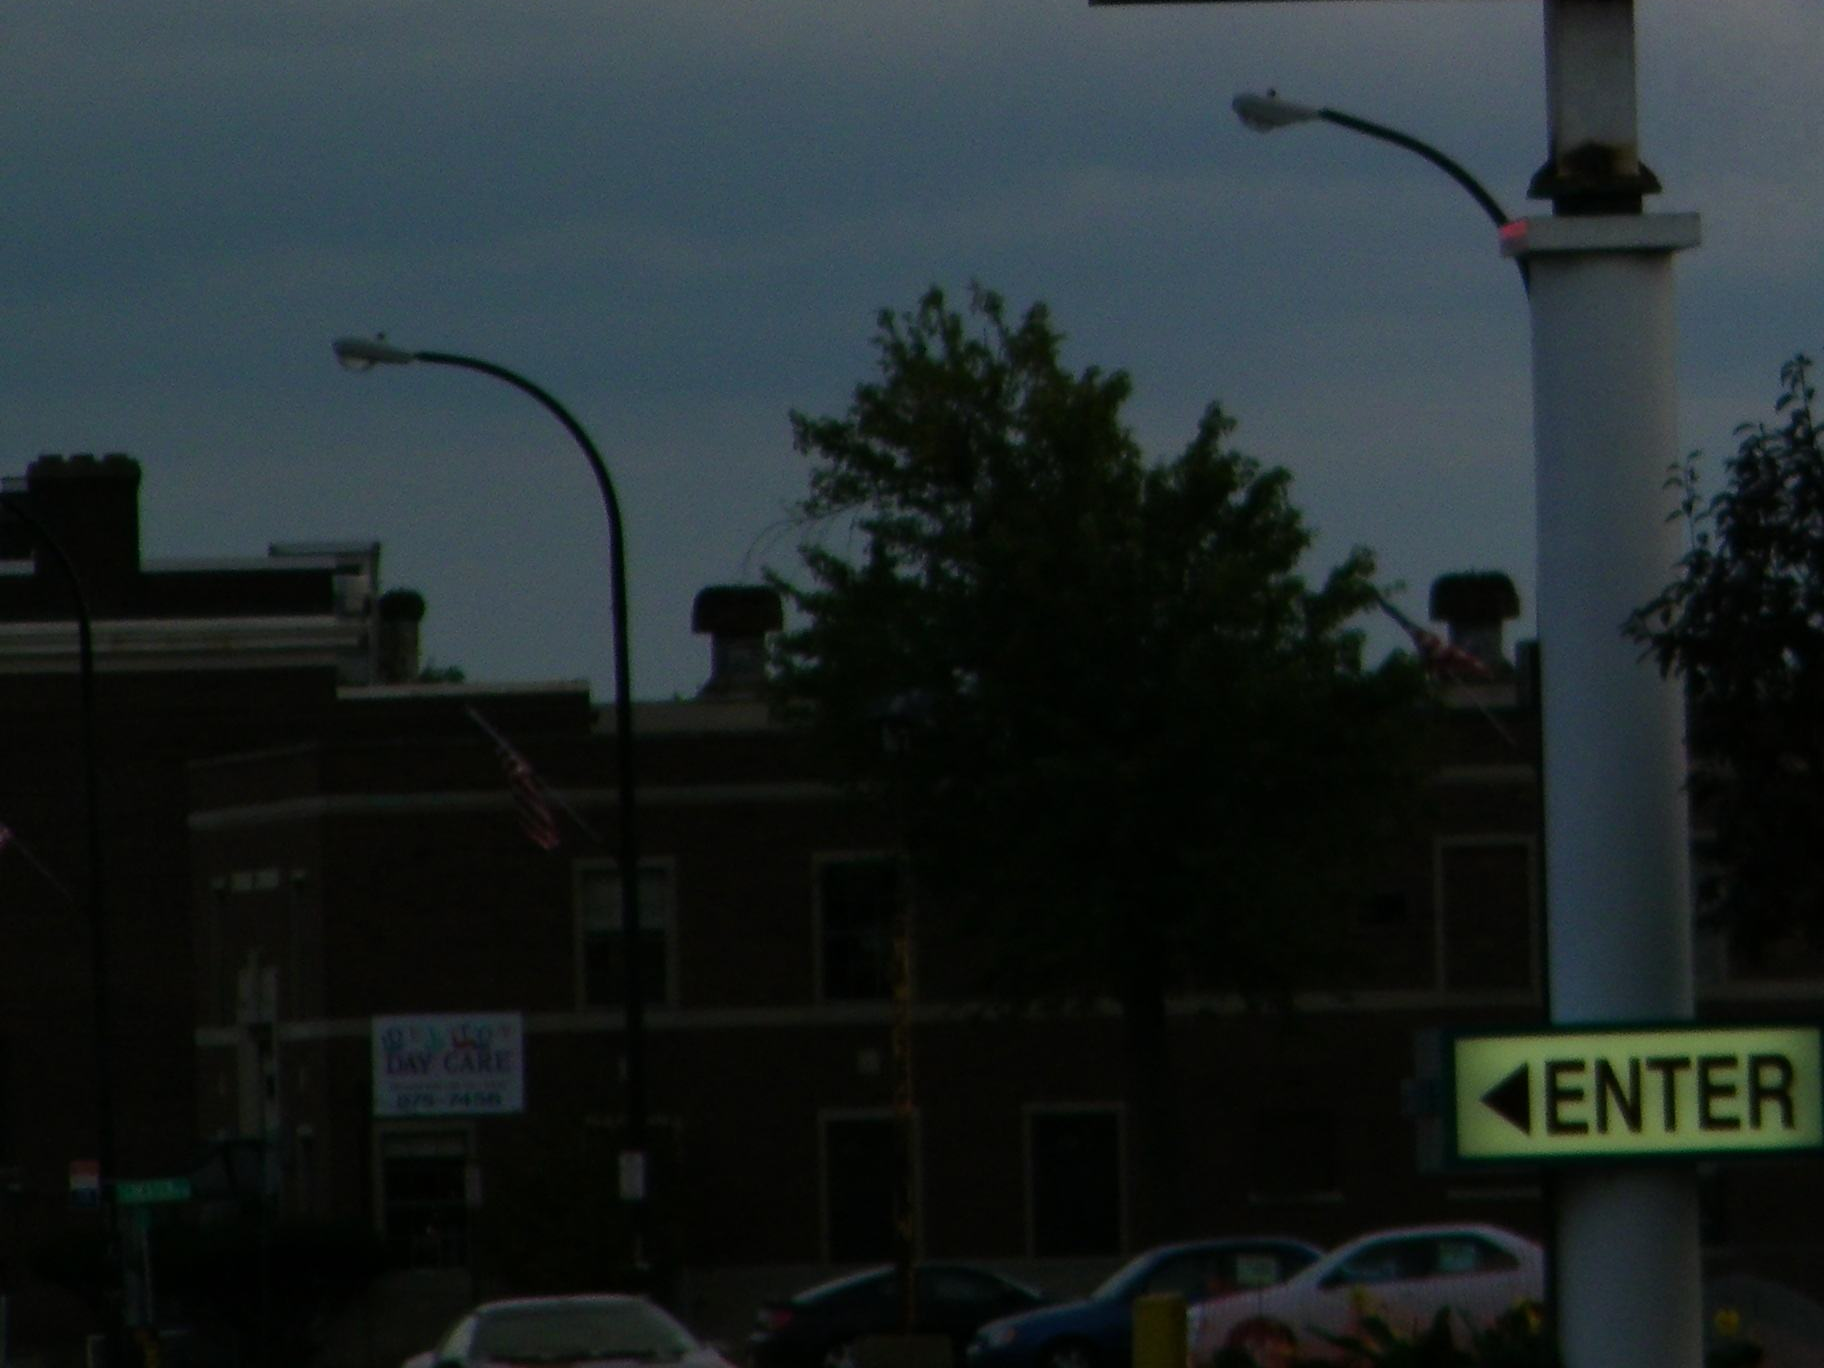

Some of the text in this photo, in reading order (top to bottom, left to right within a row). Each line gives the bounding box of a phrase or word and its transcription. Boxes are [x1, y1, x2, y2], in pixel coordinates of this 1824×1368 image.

[385, 1049, 511, 1075] DAY CARE
[1543, 1052, 1796, 1136] ENTER
